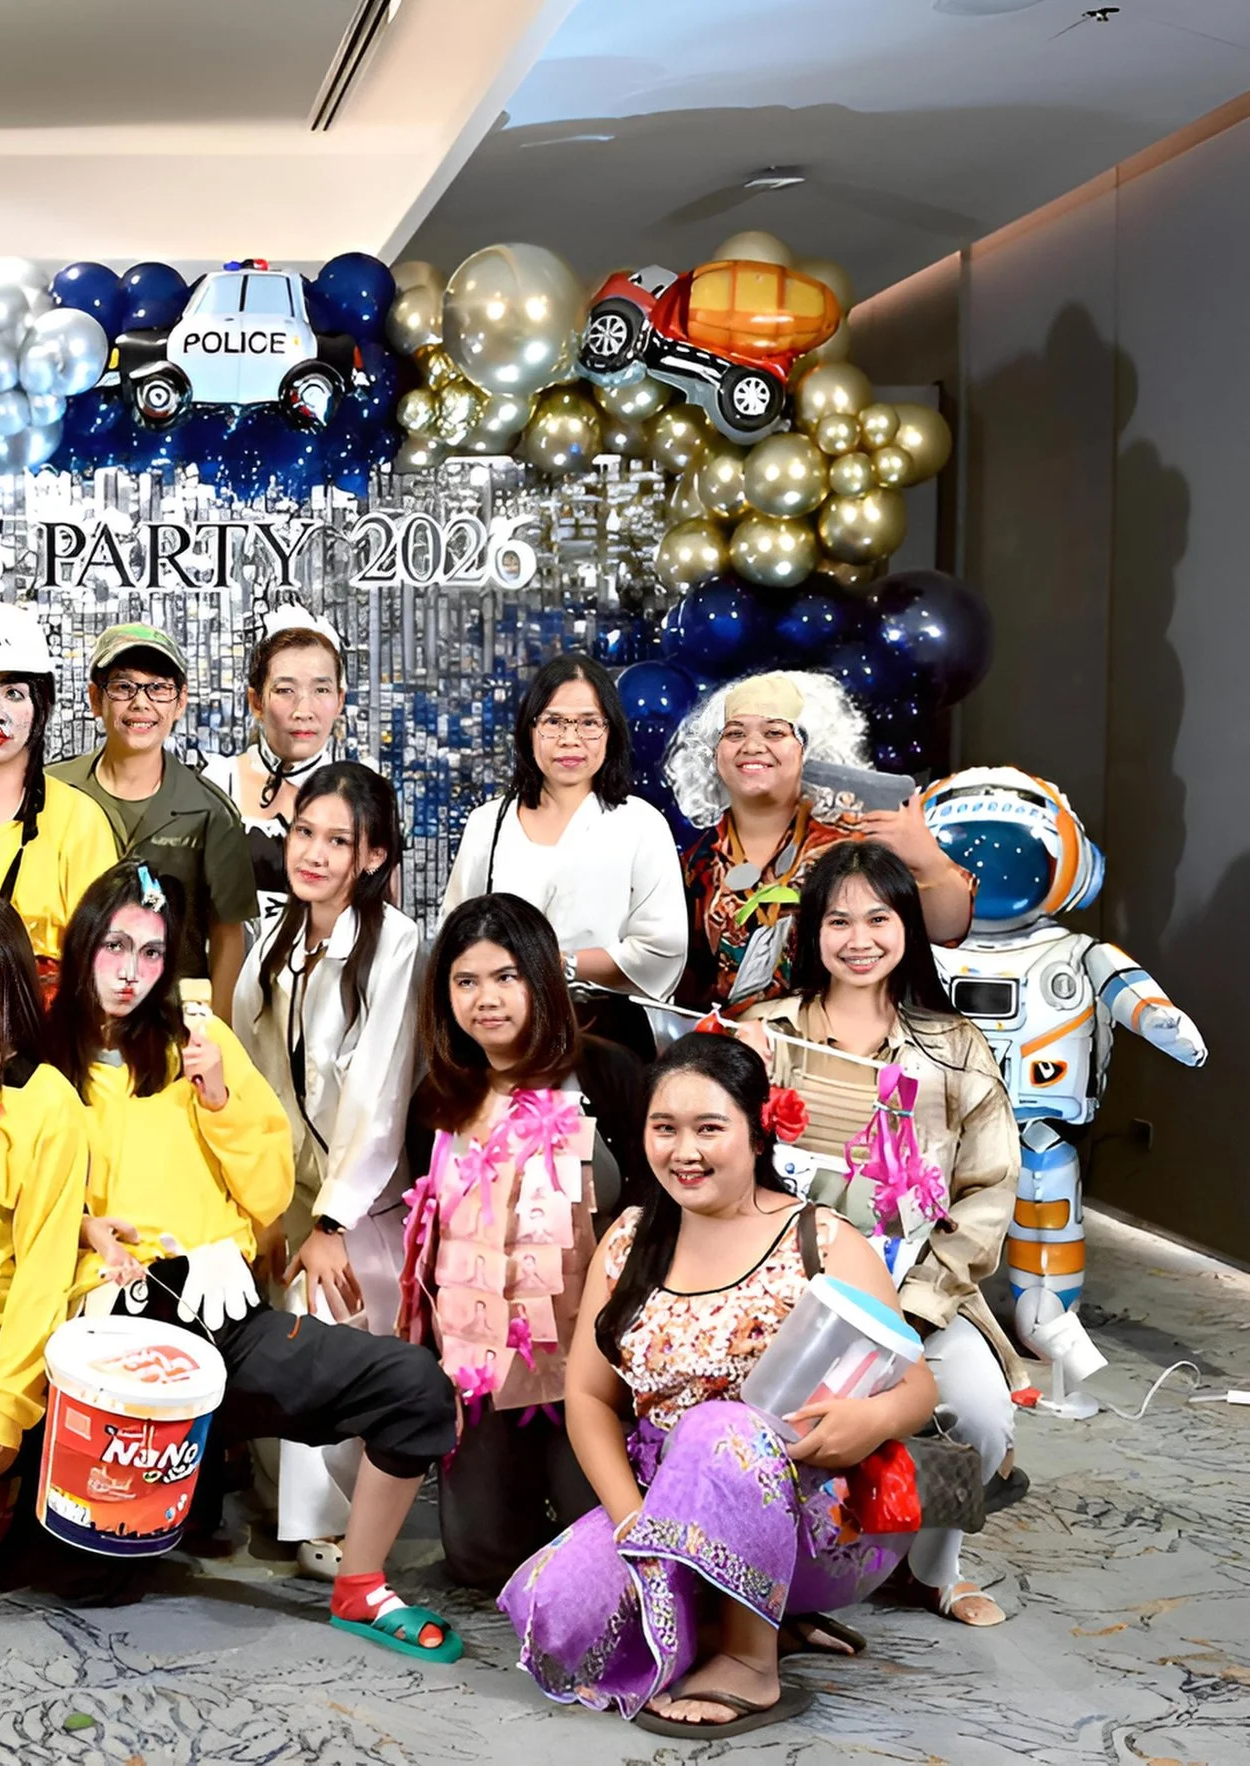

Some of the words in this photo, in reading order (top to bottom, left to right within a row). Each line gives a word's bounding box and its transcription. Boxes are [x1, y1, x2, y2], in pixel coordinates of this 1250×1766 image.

[182, 330, 287, 355] POLICE
[38, 519, 317, 591] PARTY
[350, 511, 538, 590] 2026
